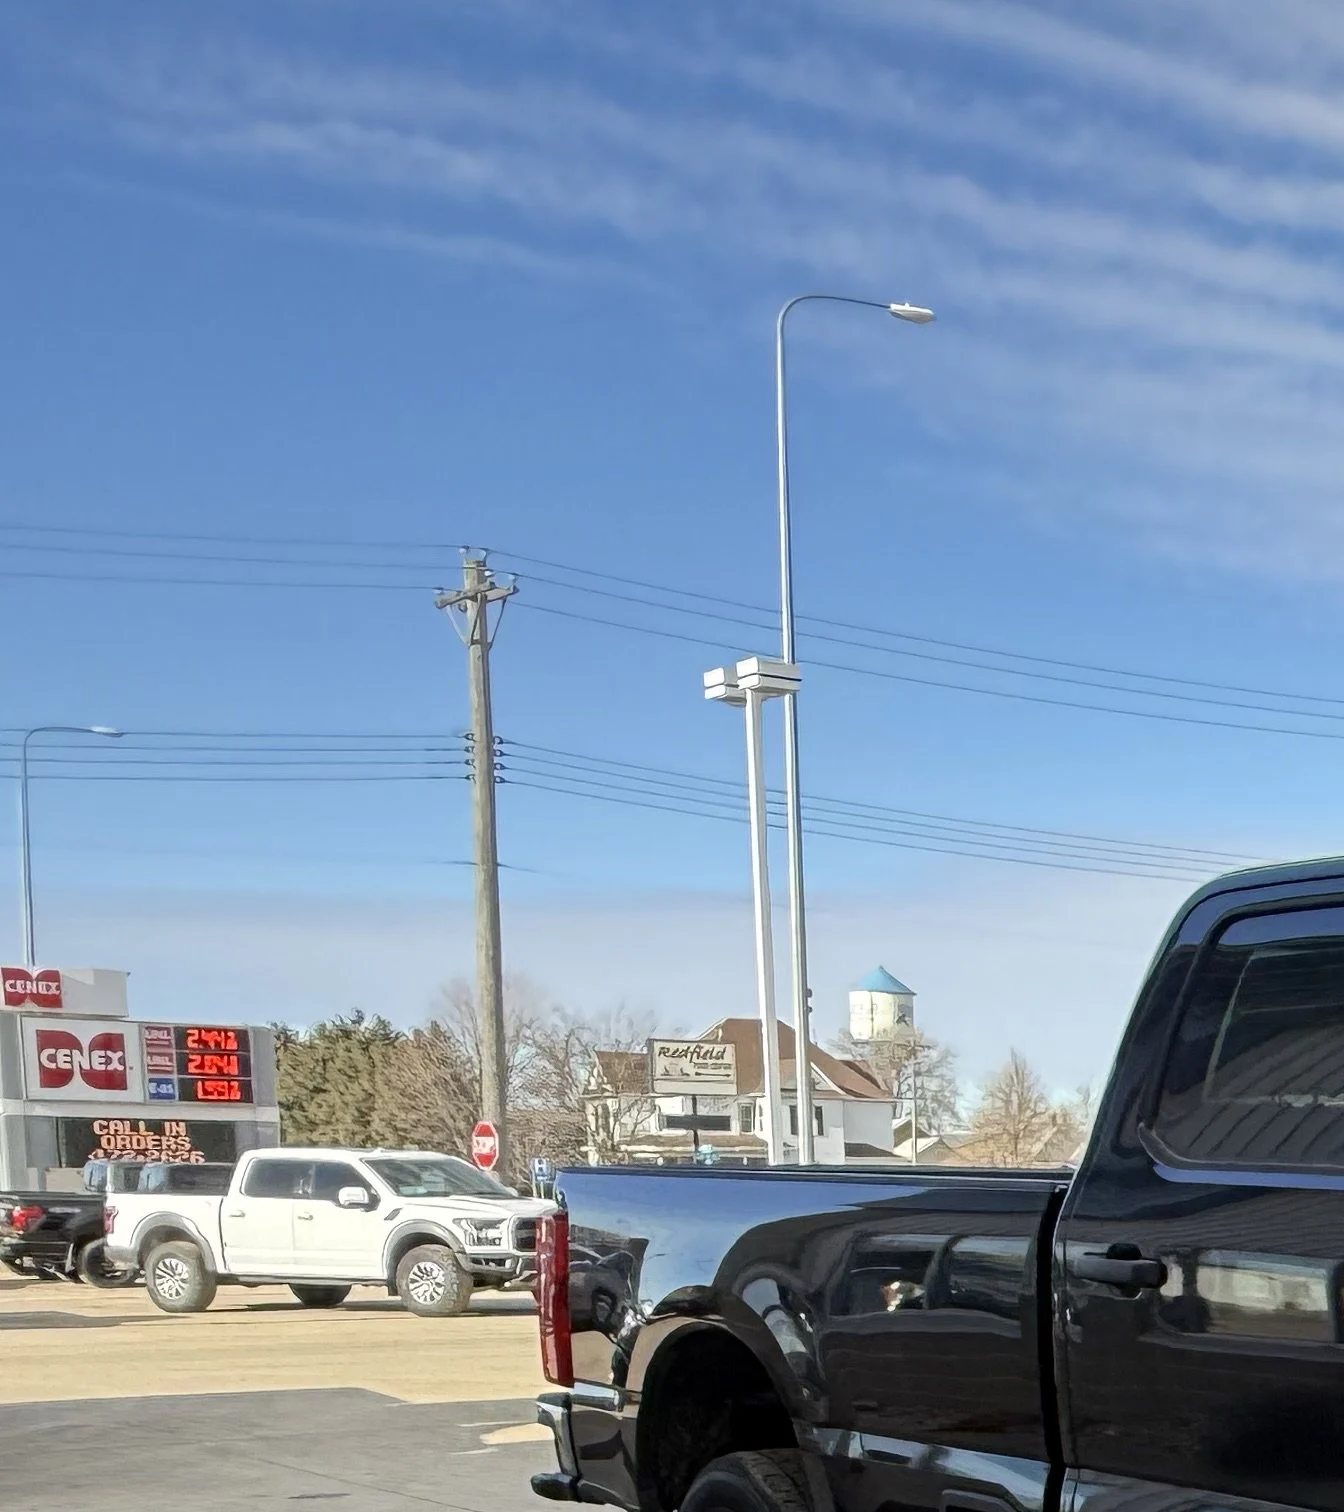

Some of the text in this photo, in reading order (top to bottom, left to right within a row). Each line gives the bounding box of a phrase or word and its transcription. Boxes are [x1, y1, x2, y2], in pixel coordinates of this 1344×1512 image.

[5, 980, 61, 995] CENEX
[39, 1048, 125, 1071] CENEX
[658, 1044, 727, 1063] Redfield
[93, 1120, 187, 1136] CALL IN
[100, 1135, 192, 1150] ORDERS
